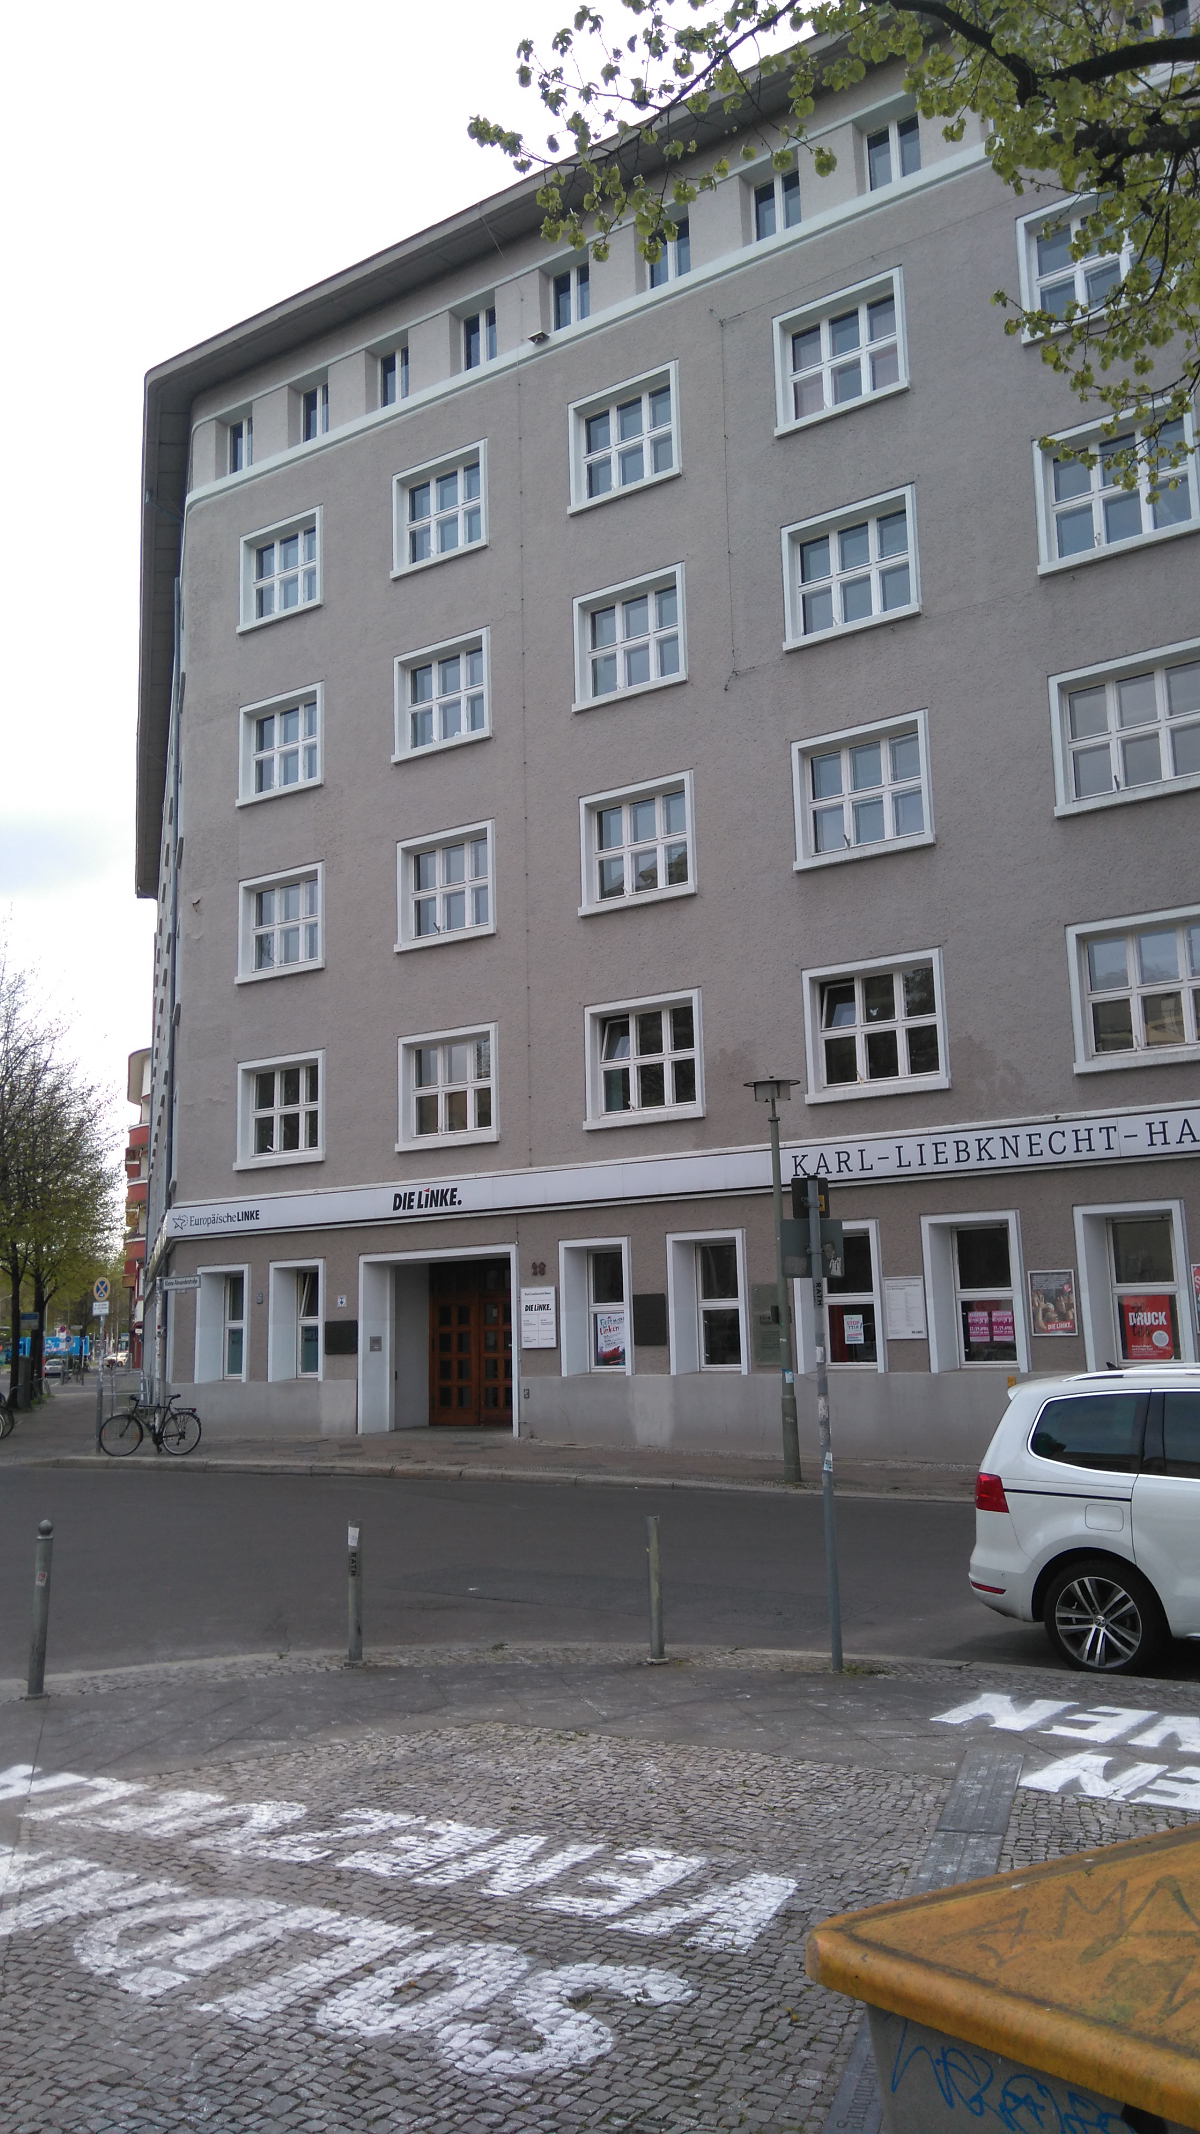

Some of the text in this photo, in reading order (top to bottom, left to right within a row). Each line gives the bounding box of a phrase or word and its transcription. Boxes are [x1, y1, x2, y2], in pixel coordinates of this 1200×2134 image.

[393, 1191, 415, 1211] DIE
[532, 1261, 546, 1276] 28
[525, 1304, 534, 1312] DIE
[1128, 1311, 1167, 1326] DRUCK
